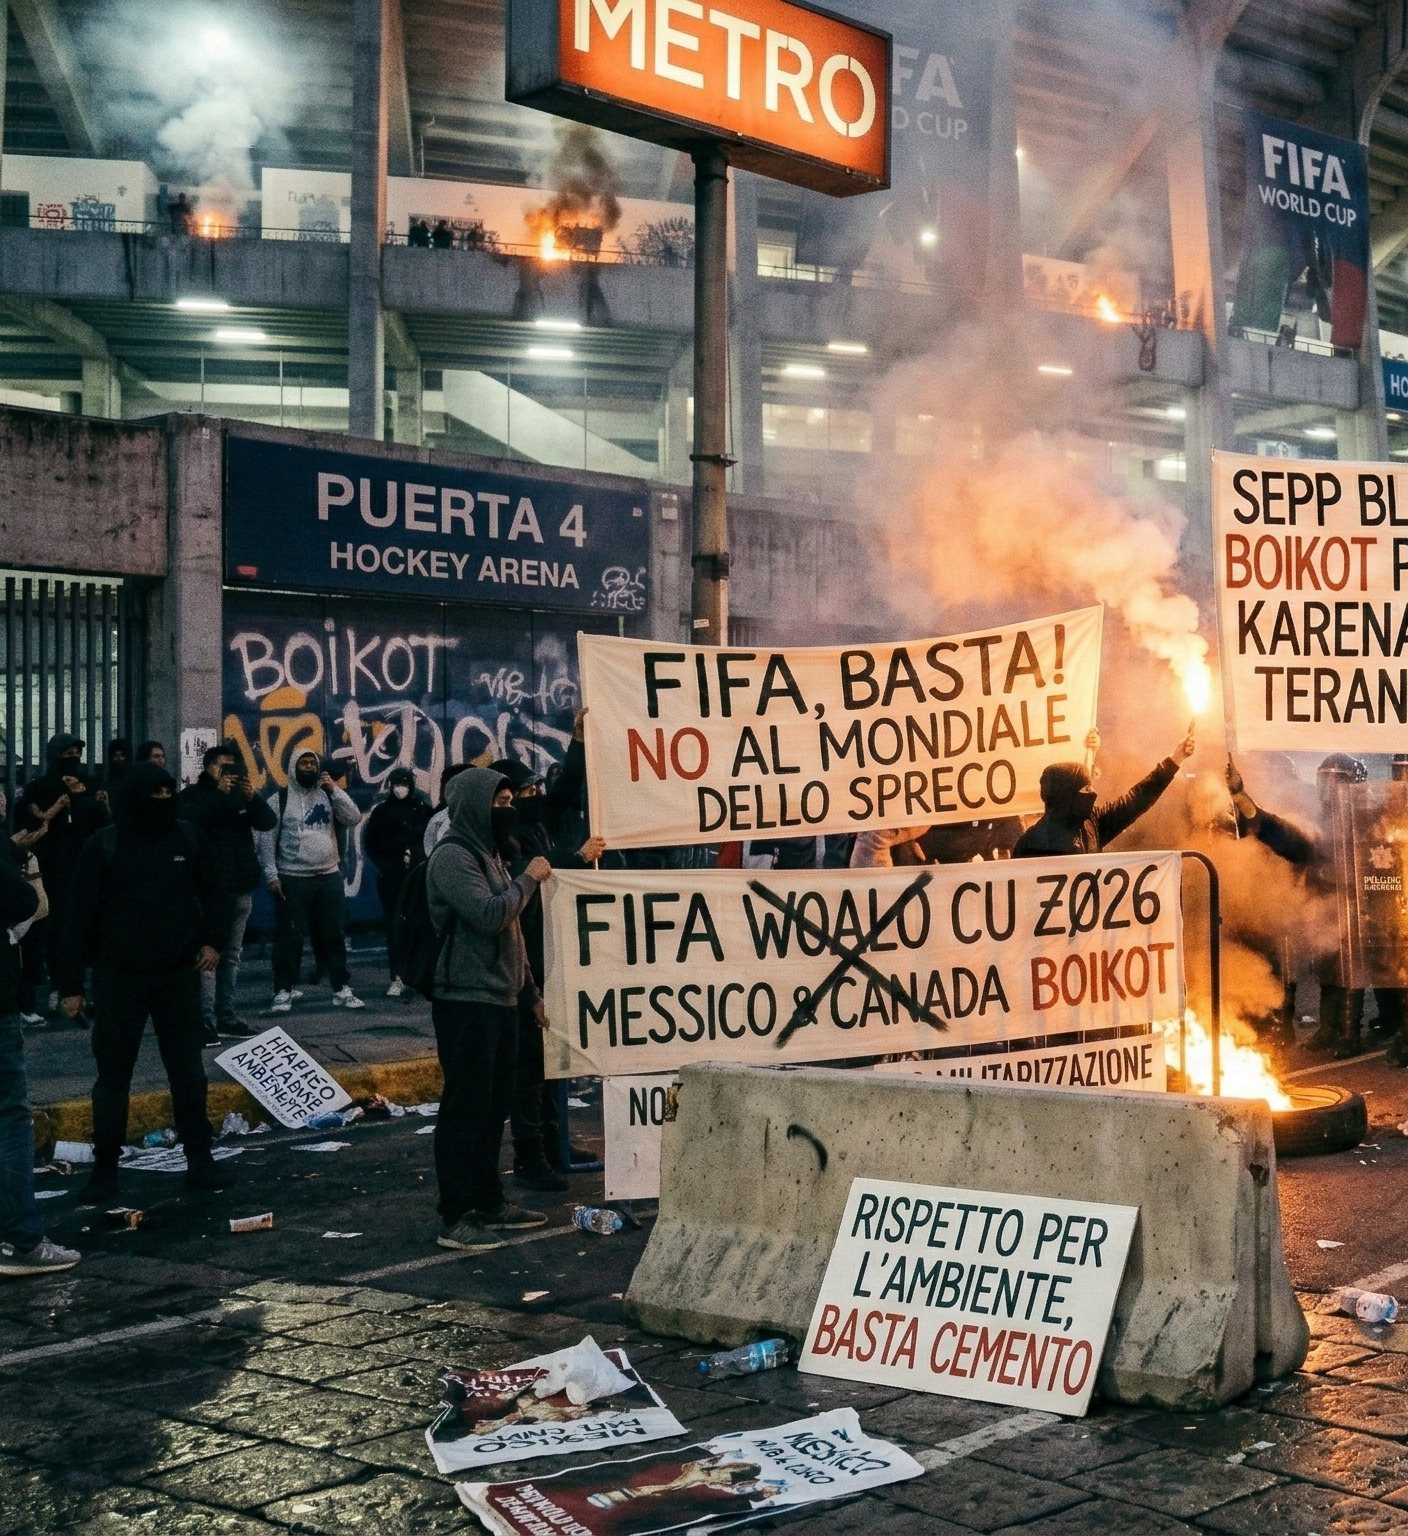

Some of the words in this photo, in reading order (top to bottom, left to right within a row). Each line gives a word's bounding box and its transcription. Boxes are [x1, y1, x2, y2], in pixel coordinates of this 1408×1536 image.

[574, 0, 877, 138] METRO
[892, 43, 963, 108] FA
[917, 111, 968, 140] CUP
[1261, 133, 1351, 200] FIFA
[1258, 184, 1321, 218] WORLD
[1324, 203, 1357, 228] CUP
[318, 471, 544, 544] PUERTA
[559, 504, 588, 548] 4
[1232, 469, 1342, 527] SEPP
[330, 541, 470, 581] HOCKEY
[478, 555, 580, 590] ARENA
[1225, 533, 1378, 591] BOIKOT
[643, 652, 826, 721] FIFA,
[840, 623, 1067, 711] BASTA!
[627, 726, 710, 783] NO
[731, 725, 801, 778] AL
[819, 694, 1071, 772] MONDIALE
[697, 780, 830, 833] DELLO
[848, 759, 1017, 821] SPRECO
[576, 892, 725, 967] FIFA
[951, 878, 1016, 945] CU
[578, 981, 777, 1050] MESSICO
[830, 964, 1011, 1028] CANADA
[1031, 942, 1175, 1011] BOIKOT
[629, 1086, 666, 1126] NO
[851, 1193, 1024, 1257] RISPETTO
[1033, 1213, 1109, 1267] PER
[853, 1251, 1073, 1332] L'AMBIENTE,
[811, 1304, 919, 1370] BASTA
[930, 1322, 1093, 1396] CEMENTO
